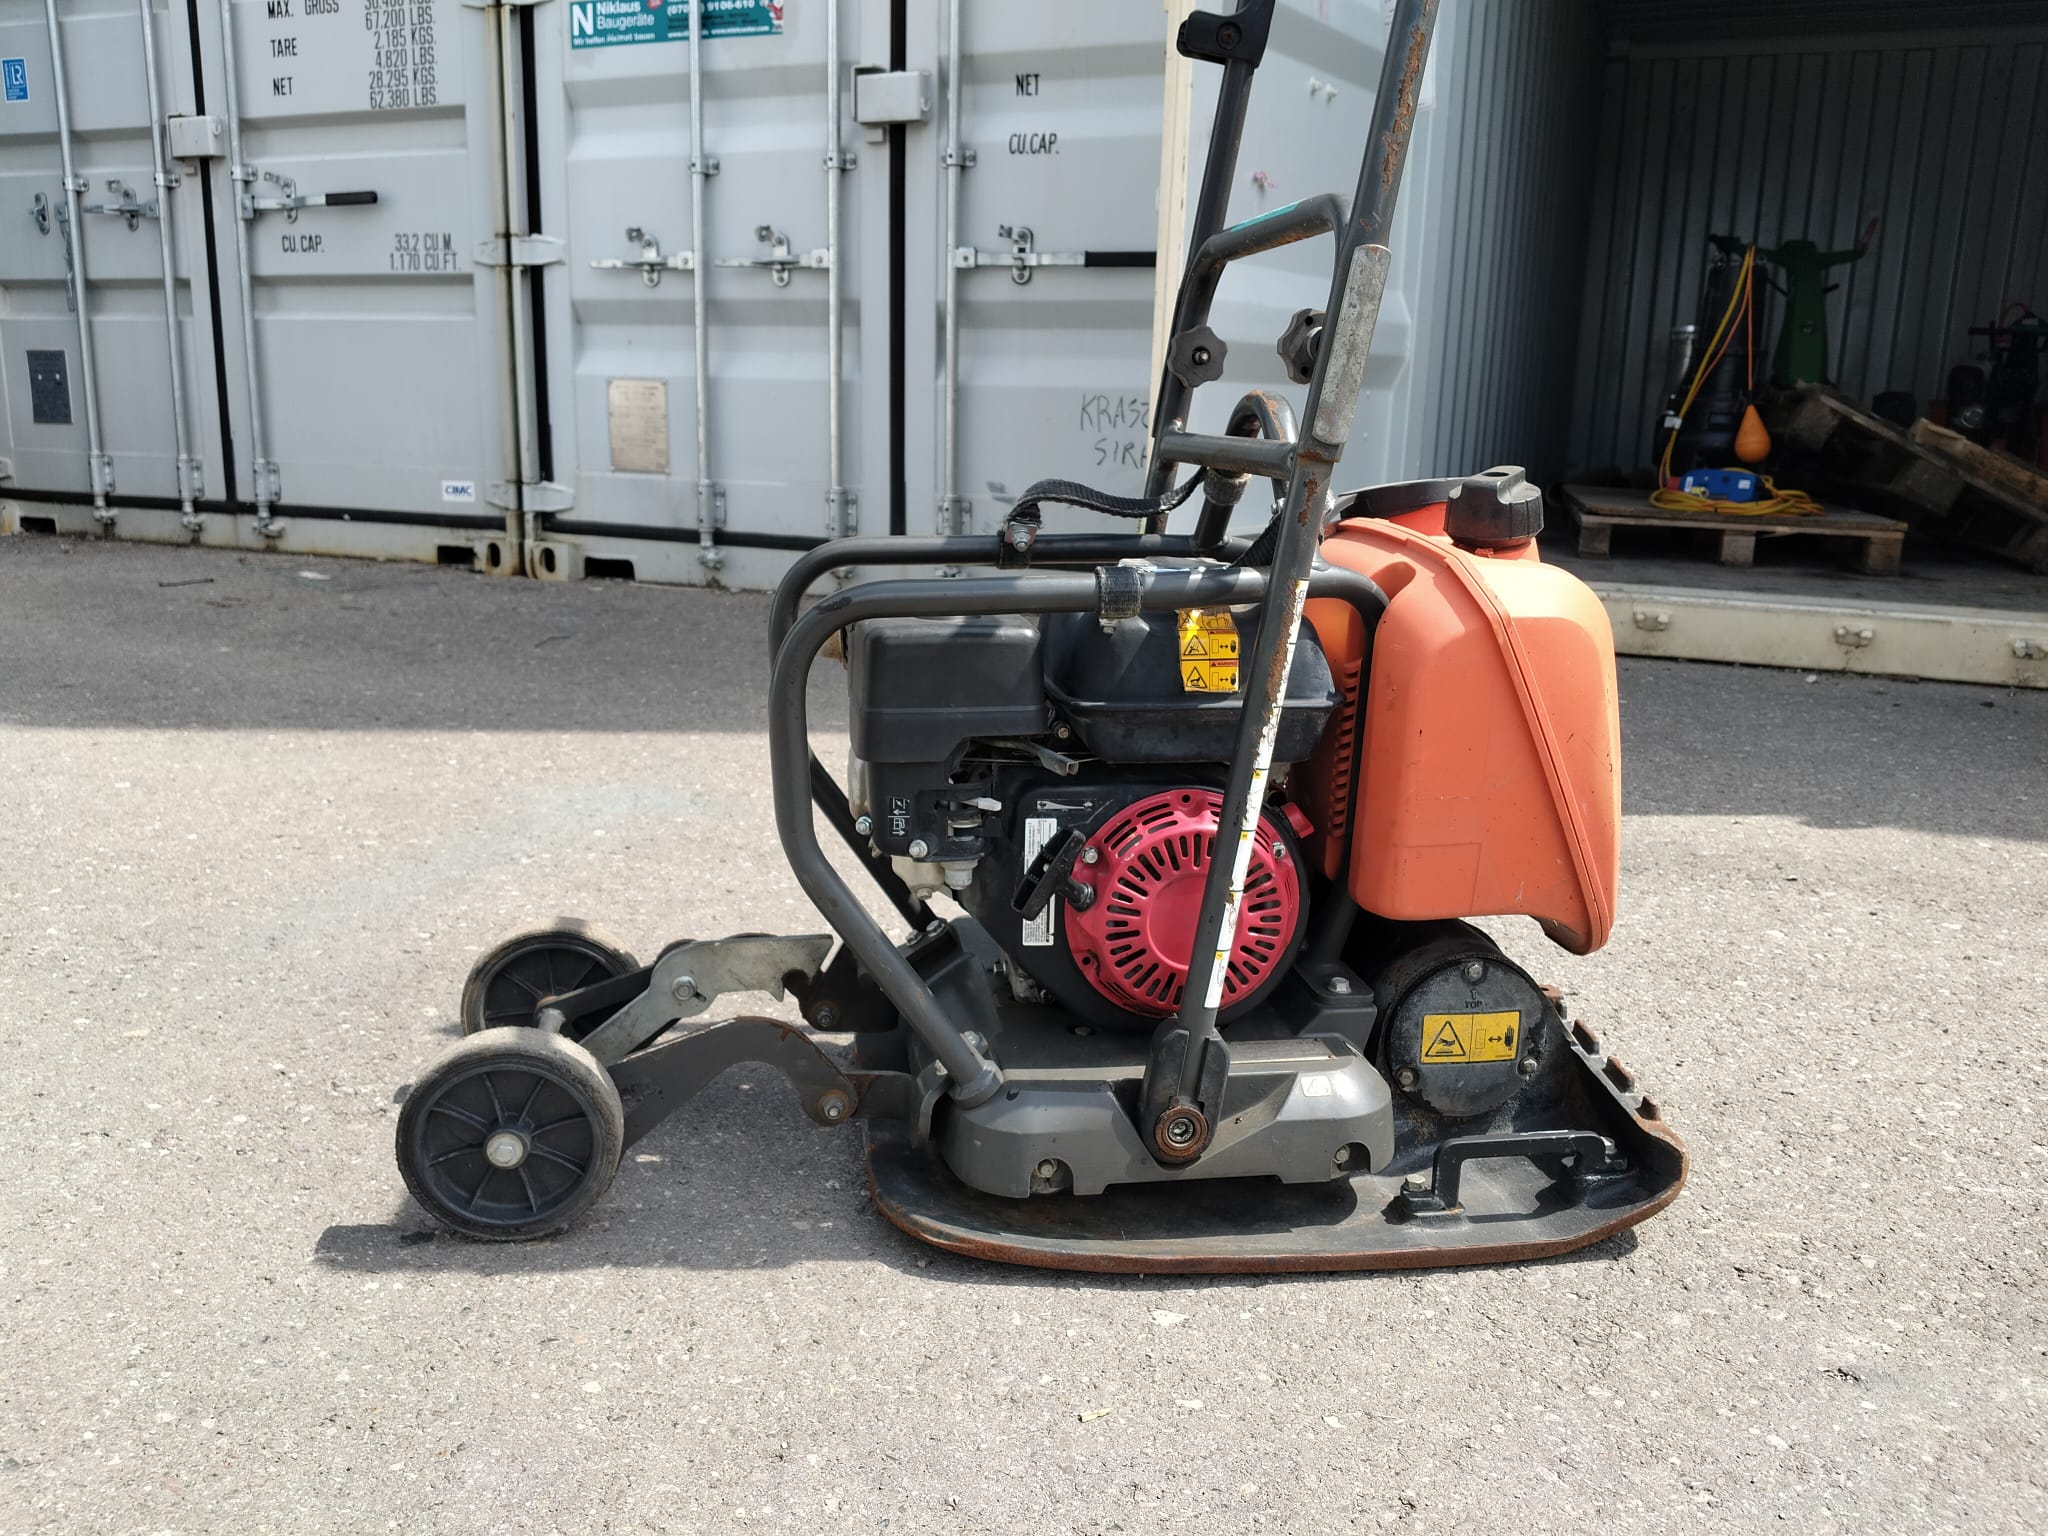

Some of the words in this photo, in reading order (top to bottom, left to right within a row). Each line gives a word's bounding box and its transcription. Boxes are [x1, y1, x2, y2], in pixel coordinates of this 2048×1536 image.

[267, 1, 294, 19] MAX.
[304, 0, 340, 16] GROSS
[365, 8, 406, 31] 67.200
[409, 5, 437, 26] LBS.
[596, 0, 641, 15] Niklaus
[572, 2, 594, 37] N
[596, 12, 655, 31] Baugeräte
[270, 37, 298, 58] TARE
[374, 28, 407, 50] 2.185
[410, 26, 437, 46] KGS.
[375, 48, 408, 69] 4.820
[411, 46, 438, 66] LBS.
[273, 77, 293, 96] NET
[368, 68, 409, 90] 28.295
[412, 66, 439, 87] KGS.
[1016, 73, 1041, 96] NET
[369, 88, 410, 110] 62.380
[413, 86, 440, 107] LBS.
[389, 252, 421, 272] 1.170
